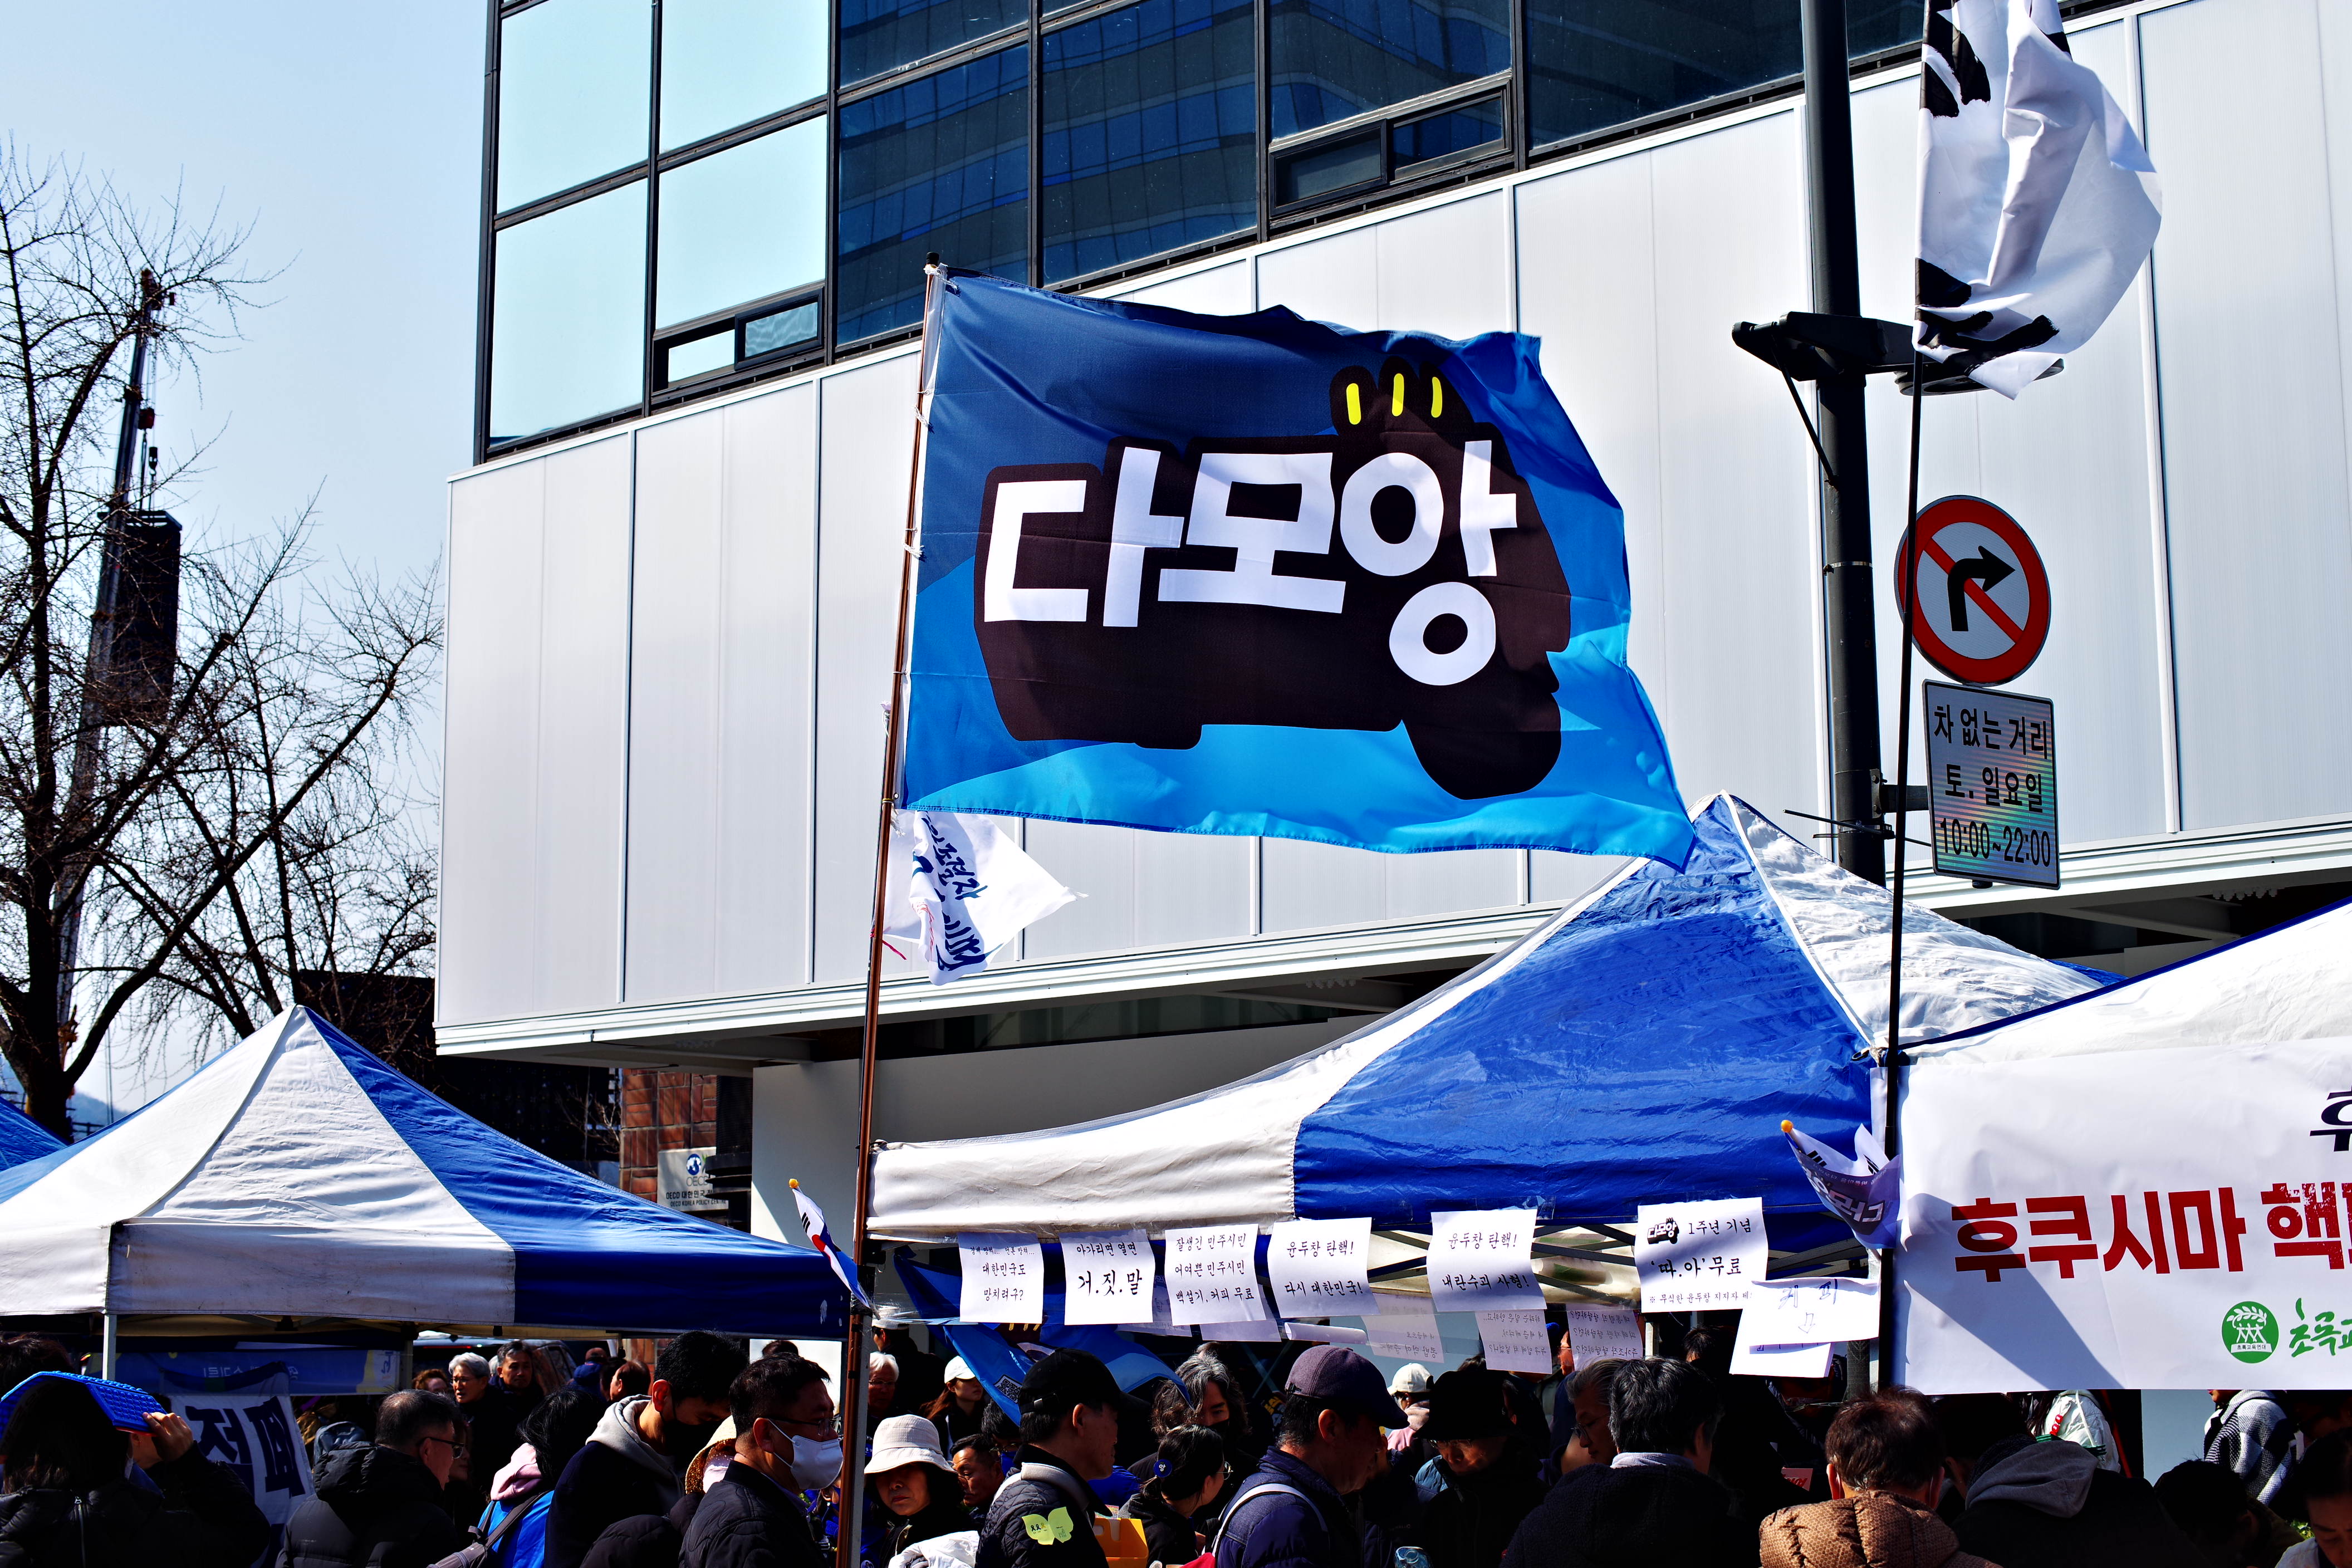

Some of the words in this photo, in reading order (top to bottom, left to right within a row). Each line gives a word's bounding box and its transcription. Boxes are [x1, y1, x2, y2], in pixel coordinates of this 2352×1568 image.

[984, 440, 1517, 685] 다모앙
[1934, 704, 1953, 743] 차
[1961, 708, 2002, 749] 없는
[2008, 716, 2047, 759] 거리
[1982, 767, 2043, 813] 일요일
[1940, 818, 2050, 867] 10:00~22:00
[1647, 1221, 1678, 1238] 다모앙
[1688, 1220, 1719, 1236] 1주년
[1726, 1217, 1751, 1234] 기념
[1951, 1187, 2247, 1282] 후쿠시마
[2261, 1182, 2352, 1270] 핵
[1076, 1242, 1114, 1256] 아가리면
[1118, 1242, 1137, 1256] 열면
[1176, 1236, 1202, 1251] 잘생긴
[1208, 1233, 1246, 1250] 민주시민
[1287, 1241, 1321, 1257] 윤두창
[1326, 1239, 1354, 1257] 탄핵!
[1448, 1232, 1483, 1250] 윤두창
[1489, 1232, 1517, 1249] 탄핵!
[1005, 1247, 1015, 1255] 언론
[983, 1262, 1026, 1276] 대한민국도
[1175, 1263, 1203, 1278] 어여쁜
[1207, 1260, 1244, 1276] 민주시민
[1285, 1281, 1306, 1297] 다시
[1311, 1280, 1363, 1297] 대한민국!
[1442, 1273, 1492, 1291] 내란수괴
[1497, 1273, 1530, 1289] 사형!
[984, 1287, 1023, 1301] 망치려구?
[1176, 1289, 1208, 1304] 백설기,
[1211, 1288, 1229, 1302] 커피
[1234, 1287, 1254, 1301] 무료
[1660, 1293, 1683, 1304] 무식한
[1687, 1292, 1710, 1304] 윤두창
[1714, 1291, 1738, 1301] 지지자
[1742, 1291, 1752, 1300] 제
